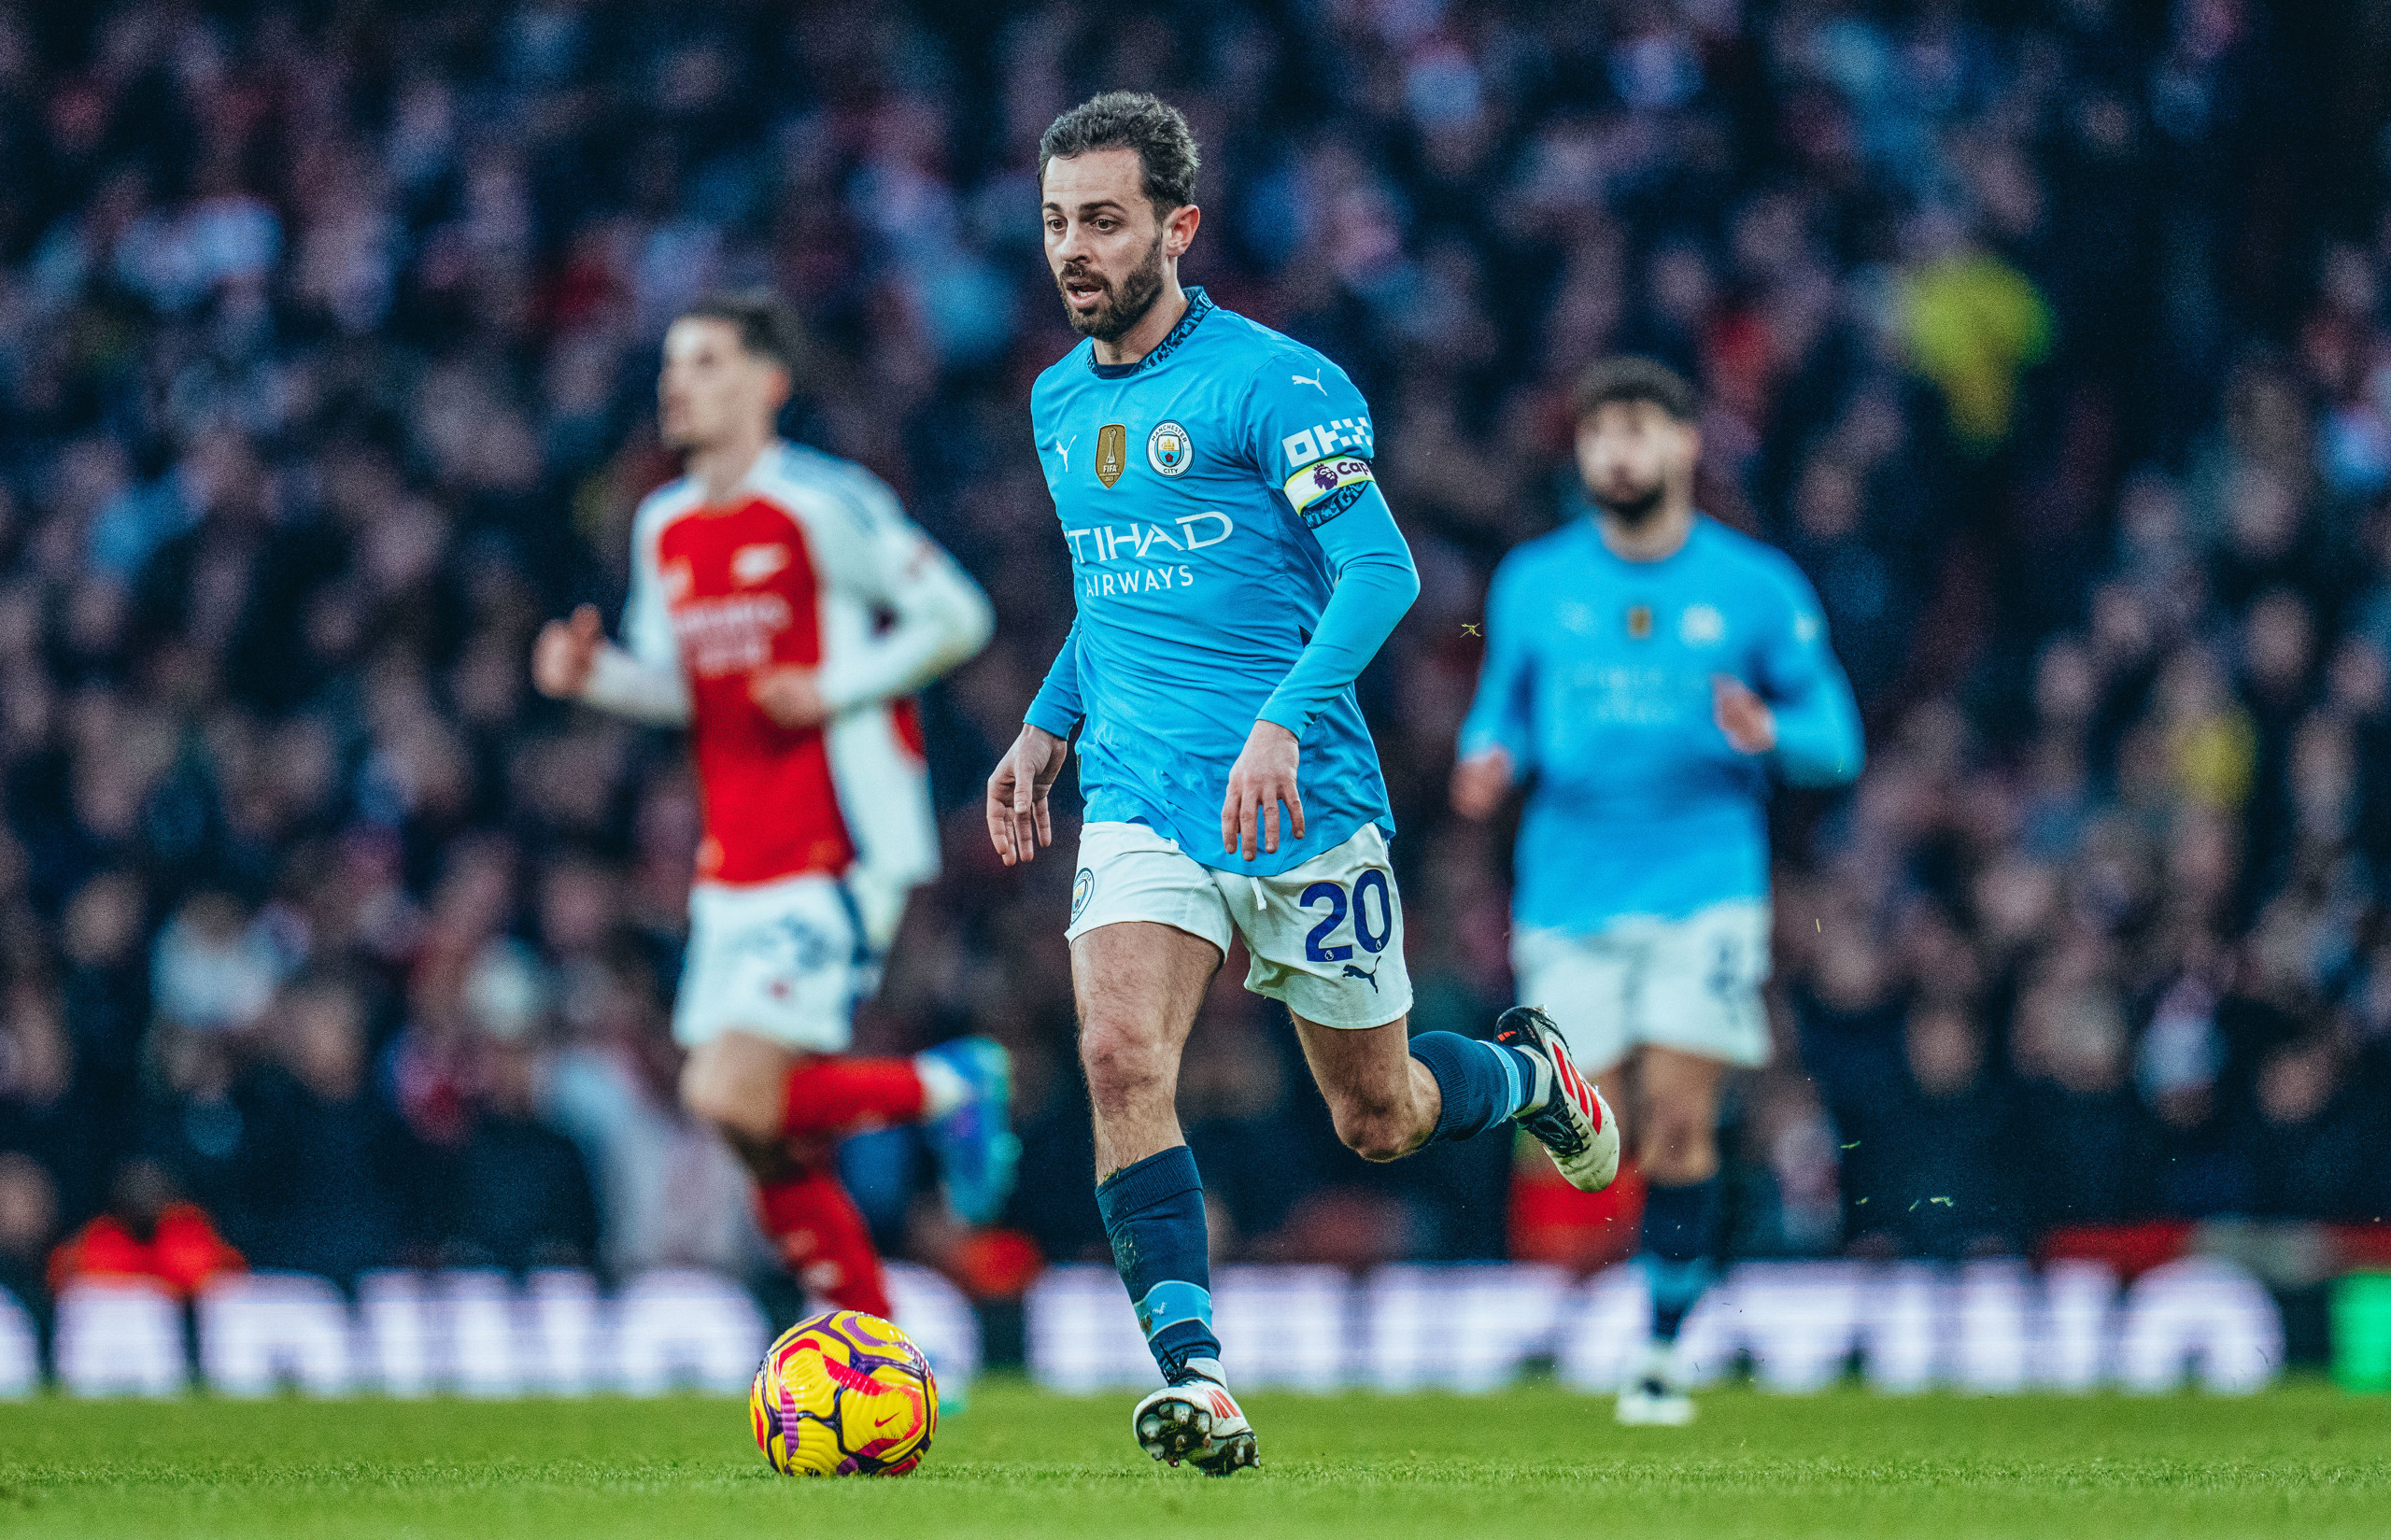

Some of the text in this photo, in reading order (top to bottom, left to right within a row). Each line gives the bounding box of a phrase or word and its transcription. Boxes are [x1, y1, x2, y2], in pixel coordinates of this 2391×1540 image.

[1152, 424, 1187, 443] MANCHESTER
[1103, 465, 1117, 473] FIFA
[1085, 565, 1194, 598] AIRWAYS
[1299, 869, 1392, 962] 20
